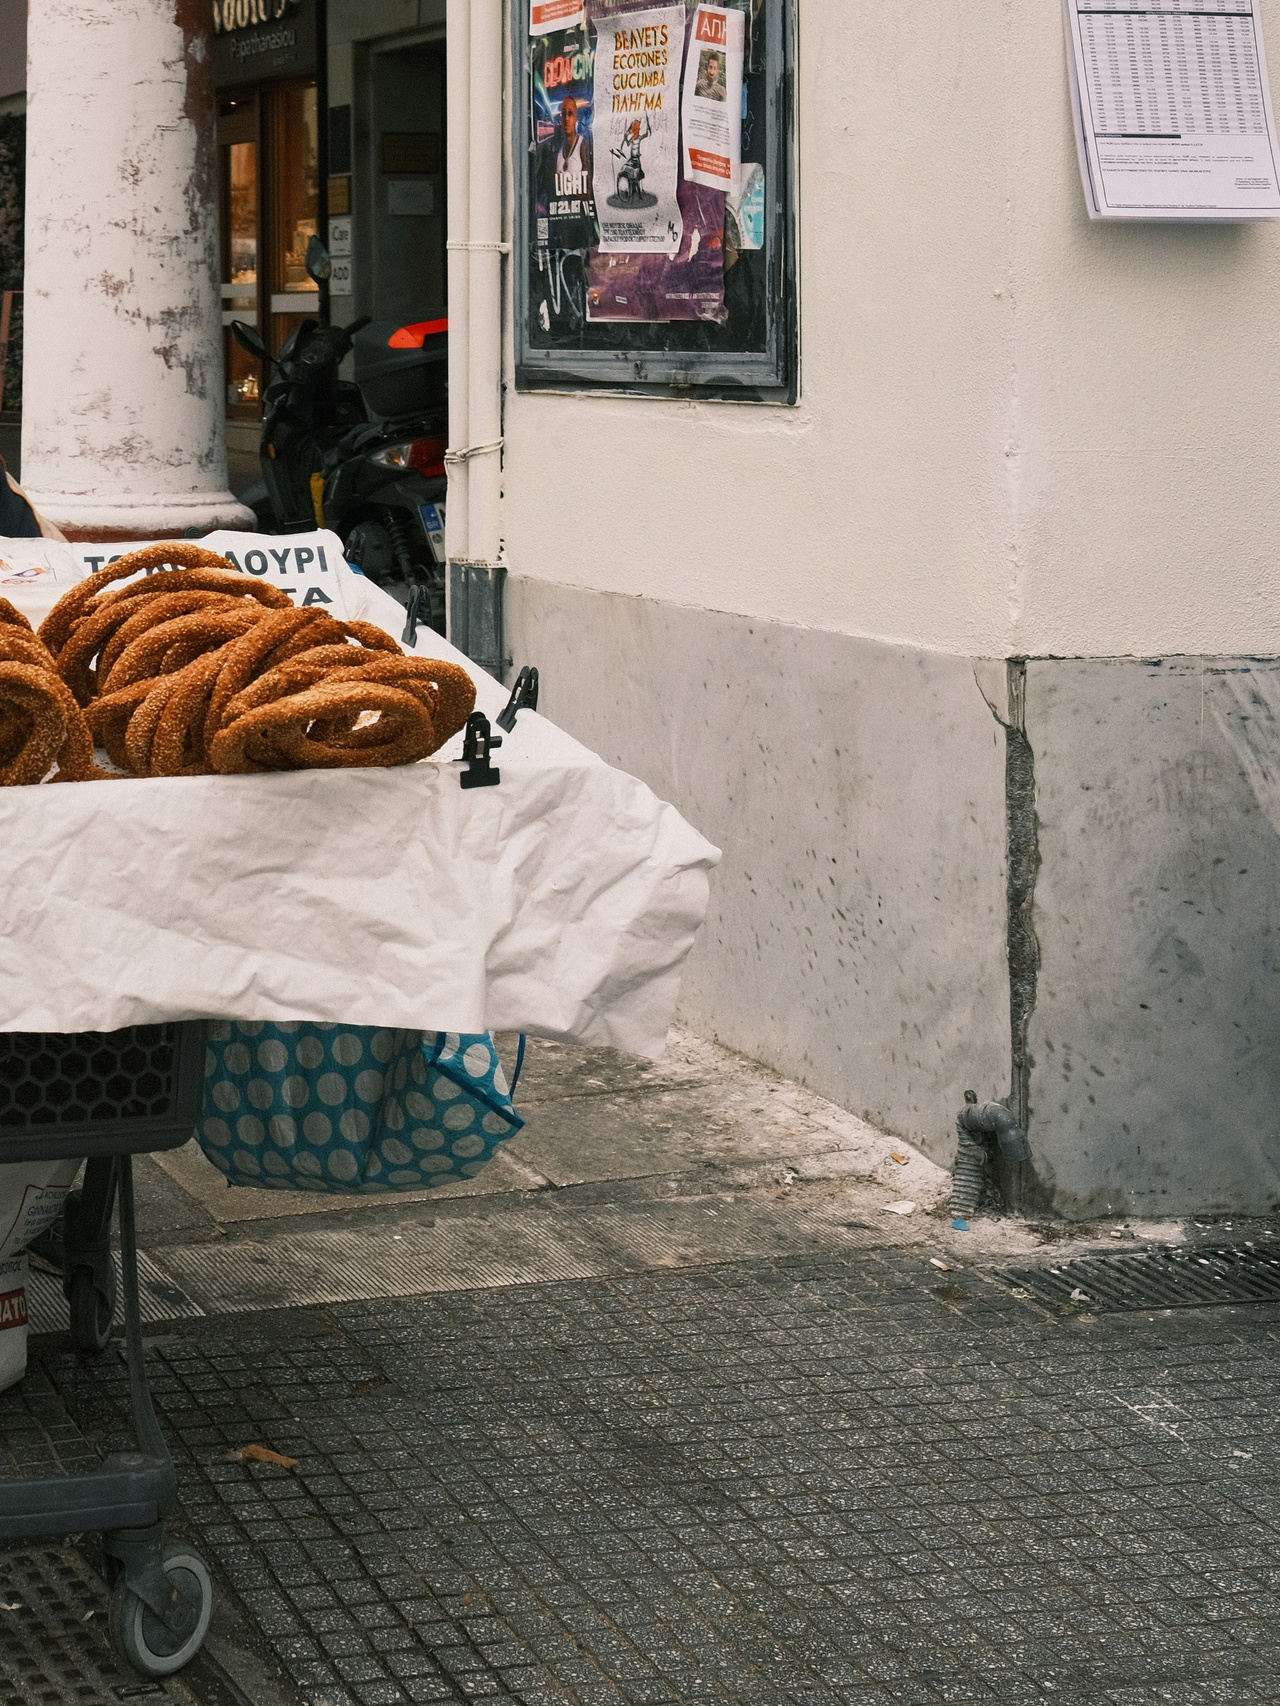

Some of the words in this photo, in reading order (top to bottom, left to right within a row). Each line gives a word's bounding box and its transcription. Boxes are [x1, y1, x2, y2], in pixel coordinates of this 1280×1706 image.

[612, 49, 669, 71] ECOTONES
[612, 69, 667, 91] CUCUMBA
[611, 92, 663, 113] ΠΛΗΓΜΑ
[554, 171, 589, 196] LIGHT
